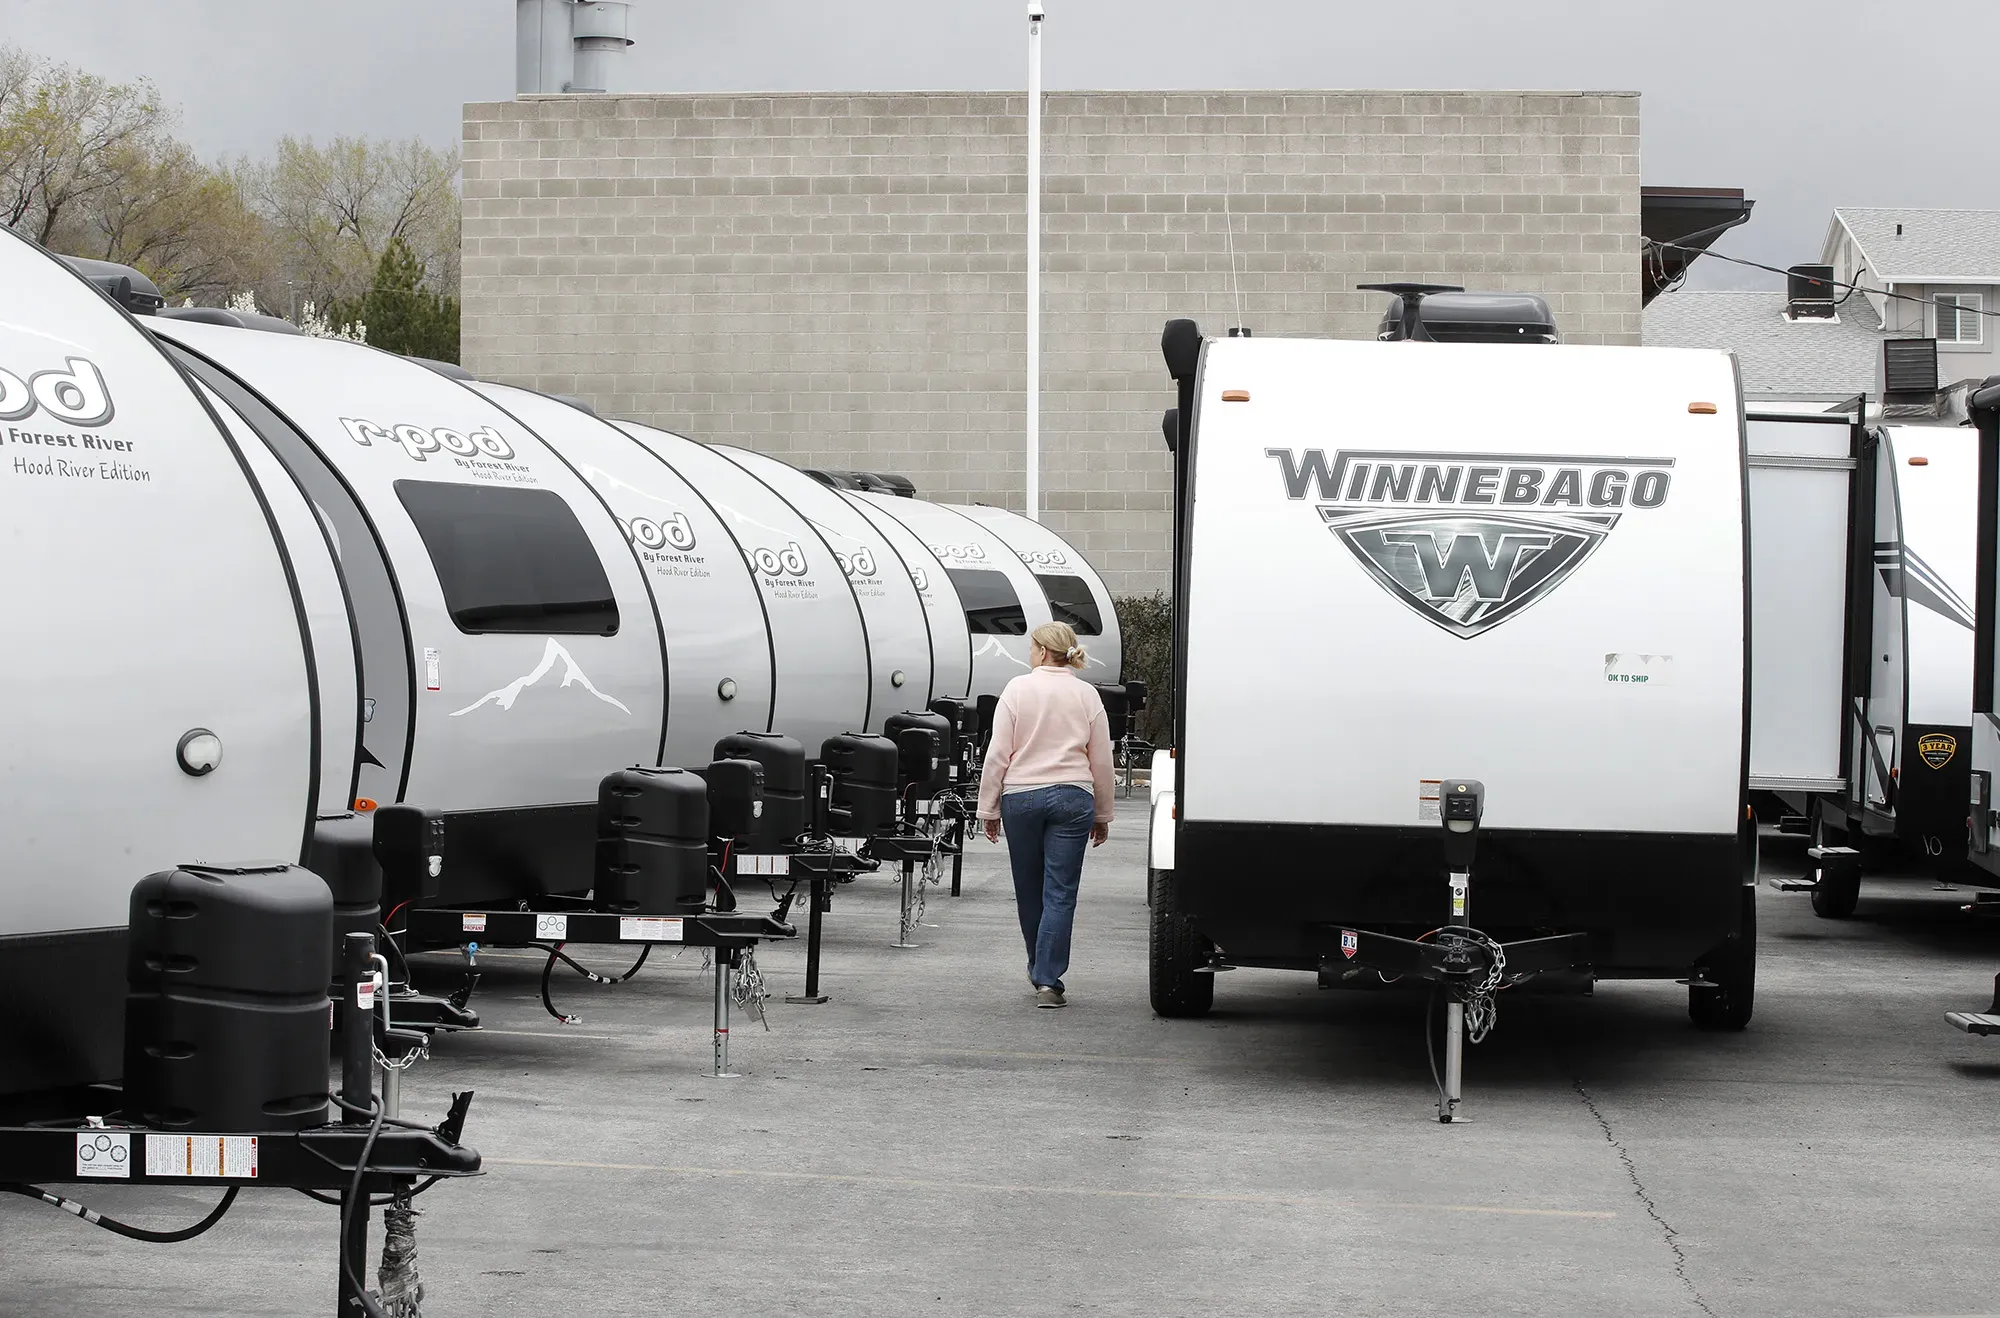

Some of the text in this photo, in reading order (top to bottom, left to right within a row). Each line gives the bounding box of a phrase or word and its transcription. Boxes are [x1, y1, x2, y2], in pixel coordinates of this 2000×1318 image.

[8, 428, 77, 448] Forest
[82, 433, 133, 452] River
[14, 456, 150, 482] Hood River Edition
[454, 458, 530, 472] By Forest River
[471, 470, 538, 484] Hood River Edition
[1264, 447, 1677, 508] WINNEBAGO
[643, 552, 704, 563] By Forest River
[657, 566, 710, 577] Hood River Edition
[1380, 532, 1555, 602] W
[765, 579, 815, 588] By Forest River
[1608, 674, 1649, 683] OK TO SHIP
[1929, 743, 1953, 751] YEAR
